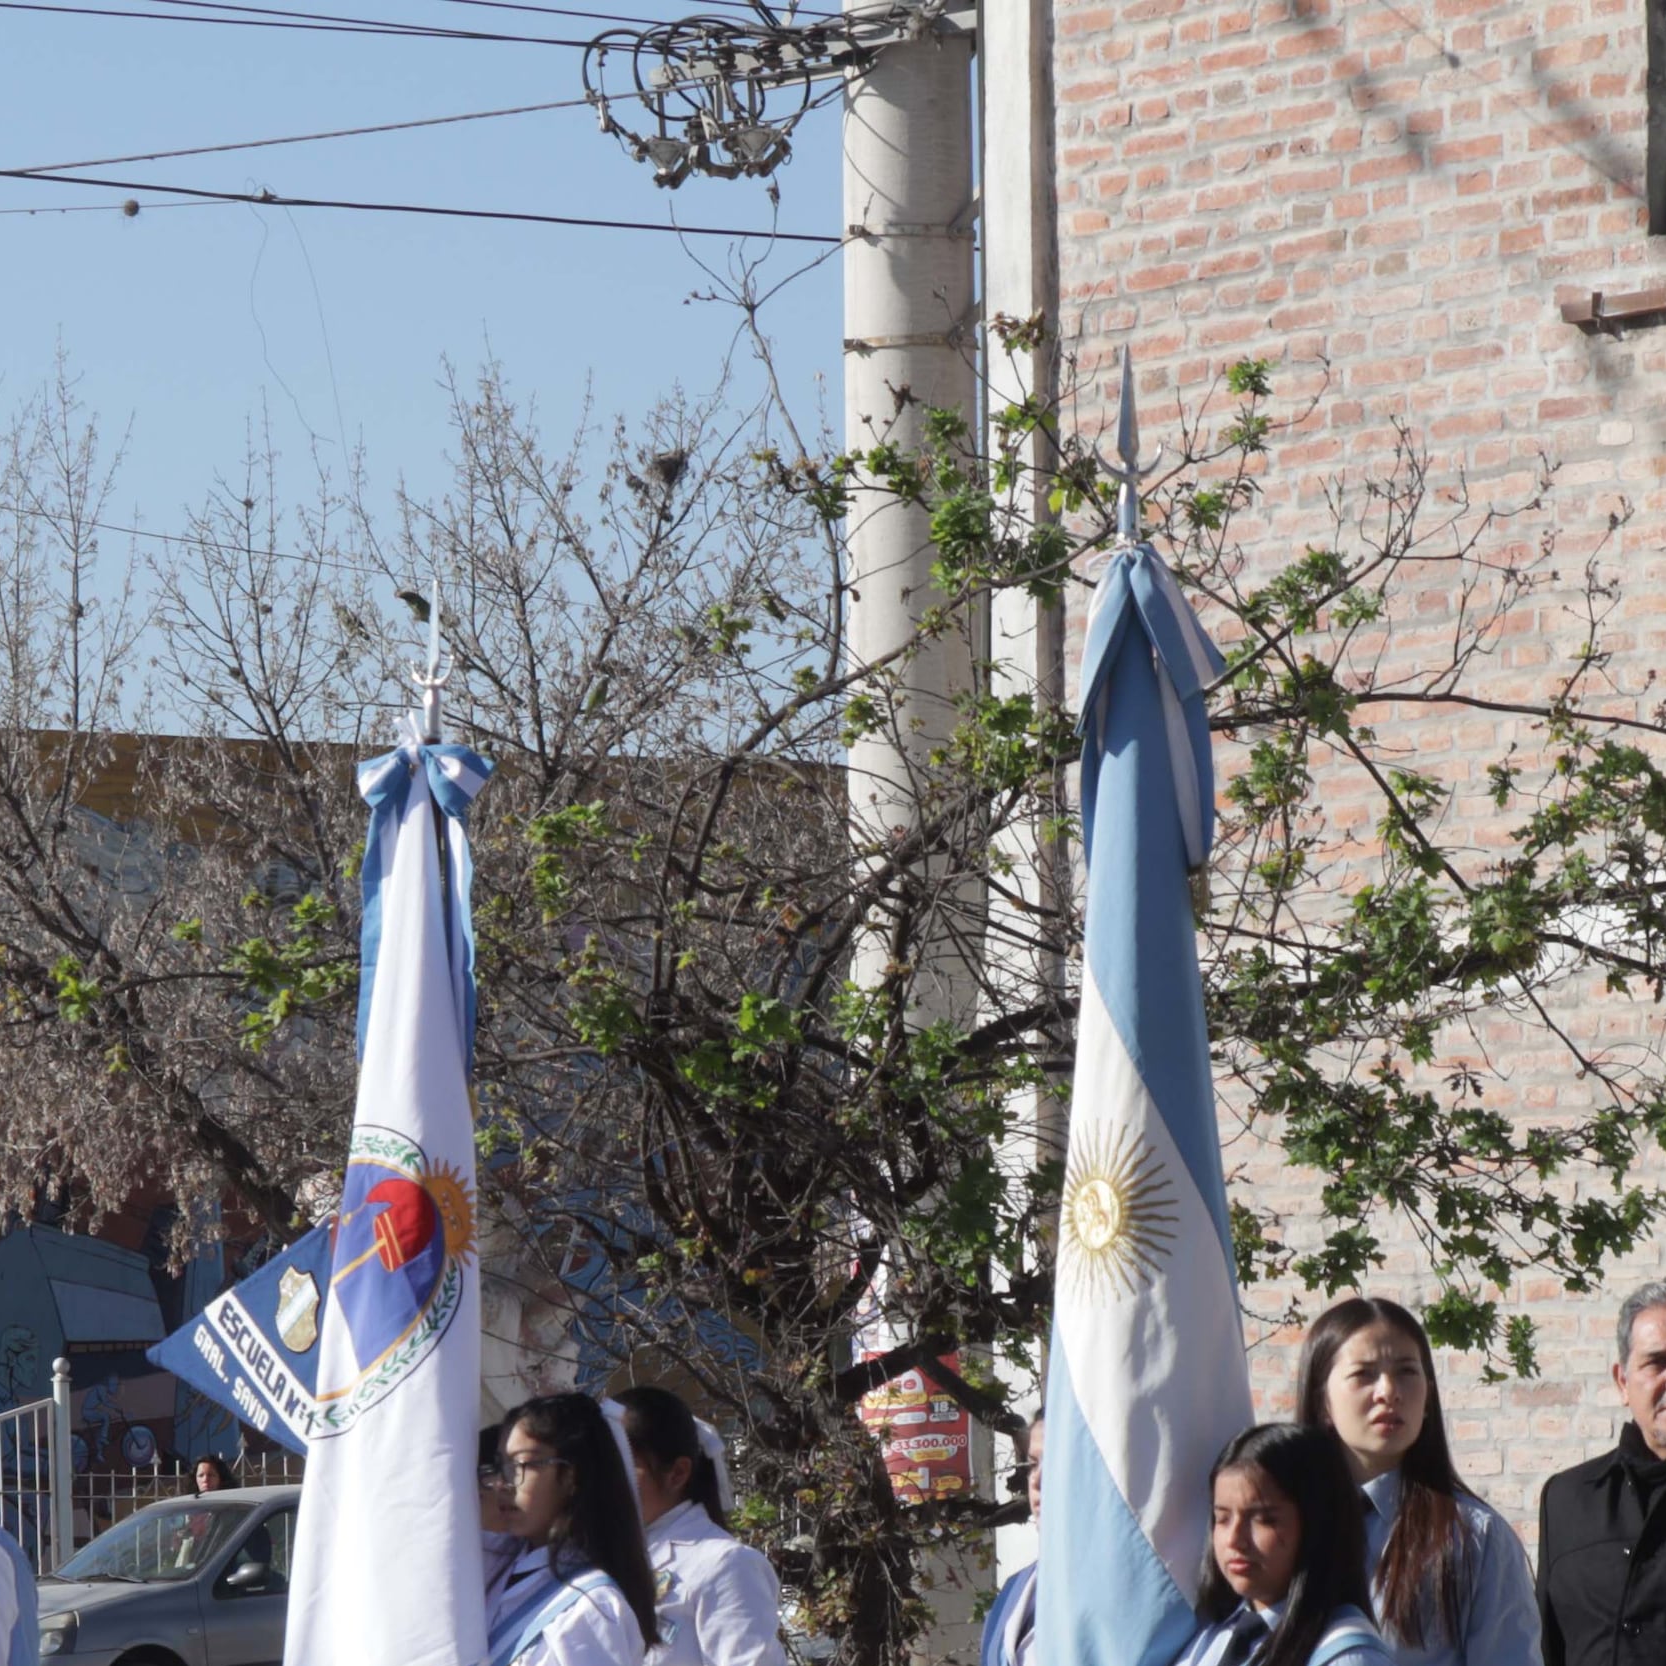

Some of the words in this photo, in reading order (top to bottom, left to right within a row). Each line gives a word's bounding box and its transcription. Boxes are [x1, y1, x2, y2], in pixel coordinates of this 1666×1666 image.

[193, 1323, 229, 1384] GRAL.
[231, 1375, 270, 1432] SAVIO
[218, 1299, 287, 1402] ESCUELA
